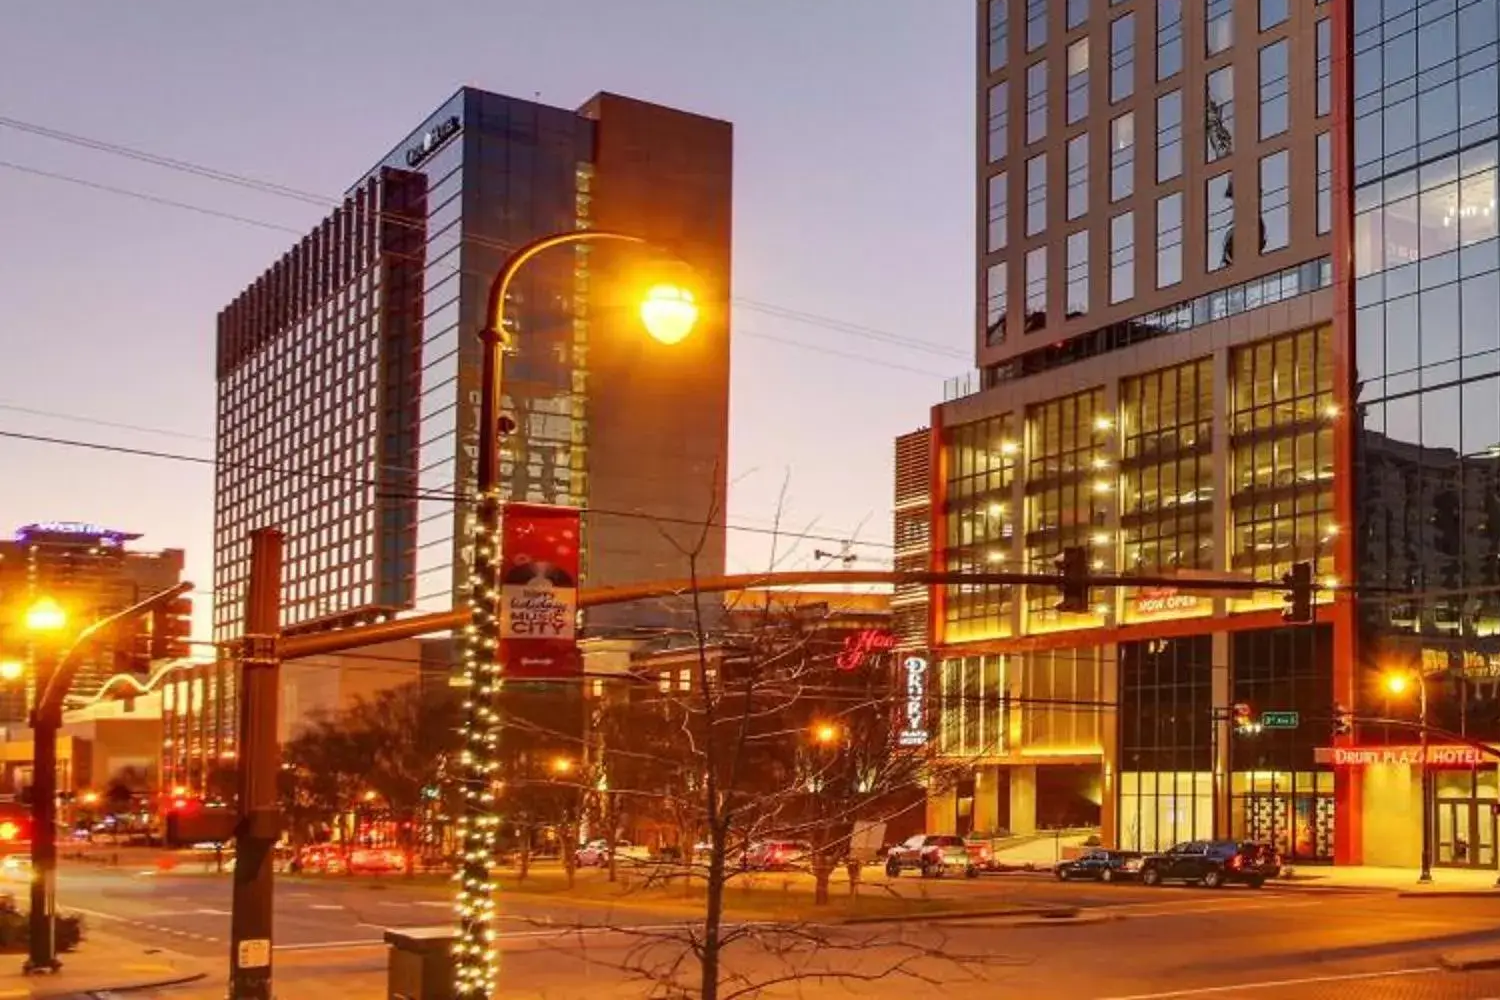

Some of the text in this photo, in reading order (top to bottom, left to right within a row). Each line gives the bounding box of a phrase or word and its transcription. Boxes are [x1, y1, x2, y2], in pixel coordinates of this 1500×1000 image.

[511, 610, 564, 622] MUSIC
[511, 622, 565, 635] CITY
[1335, 749, 1379, 764] DRURY
[1433, 749, 1484, 763] HOTEL
